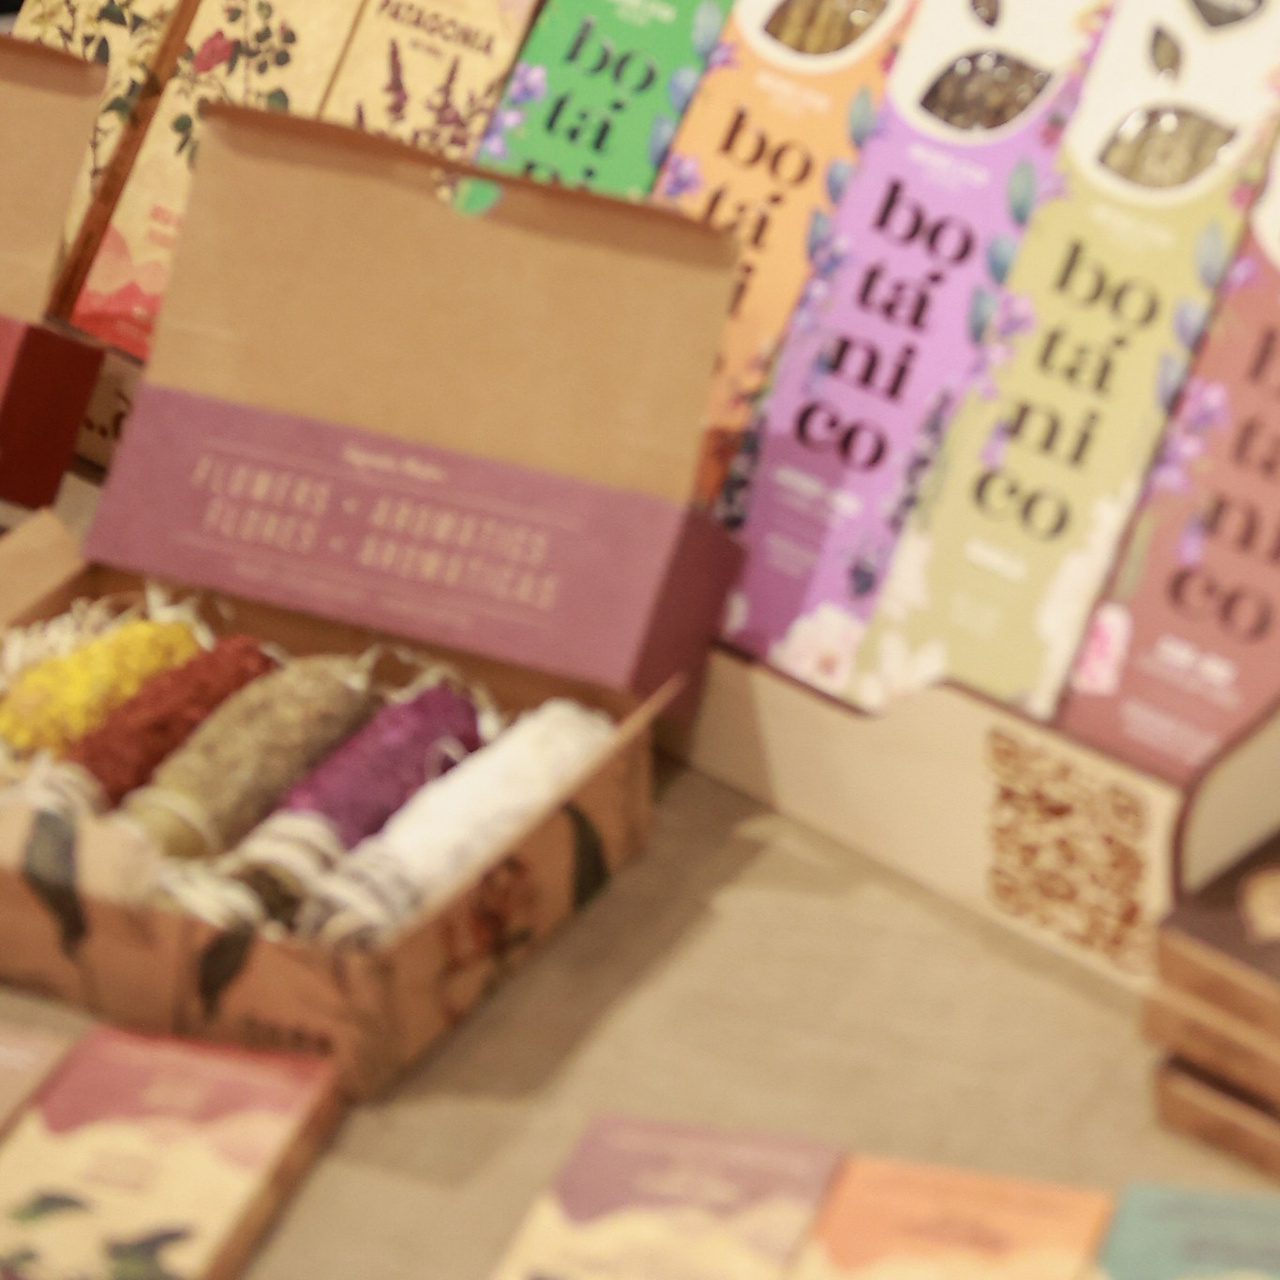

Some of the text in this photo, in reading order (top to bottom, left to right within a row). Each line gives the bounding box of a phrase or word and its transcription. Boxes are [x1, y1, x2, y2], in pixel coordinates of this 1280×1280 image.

[563, 13, 658, 95] bo
[716, 104, 815, 187] bo
[871, 176, 977, 267] bo
[1054, 237, 1161, 329] bo
[827, 336, 917, 400] ni
[793, 401, 888, 471] co
[1005, 401, 1100, 469] ni
[970, 469, 1072, 541] co
[1165, 567, 1277, 643] co
